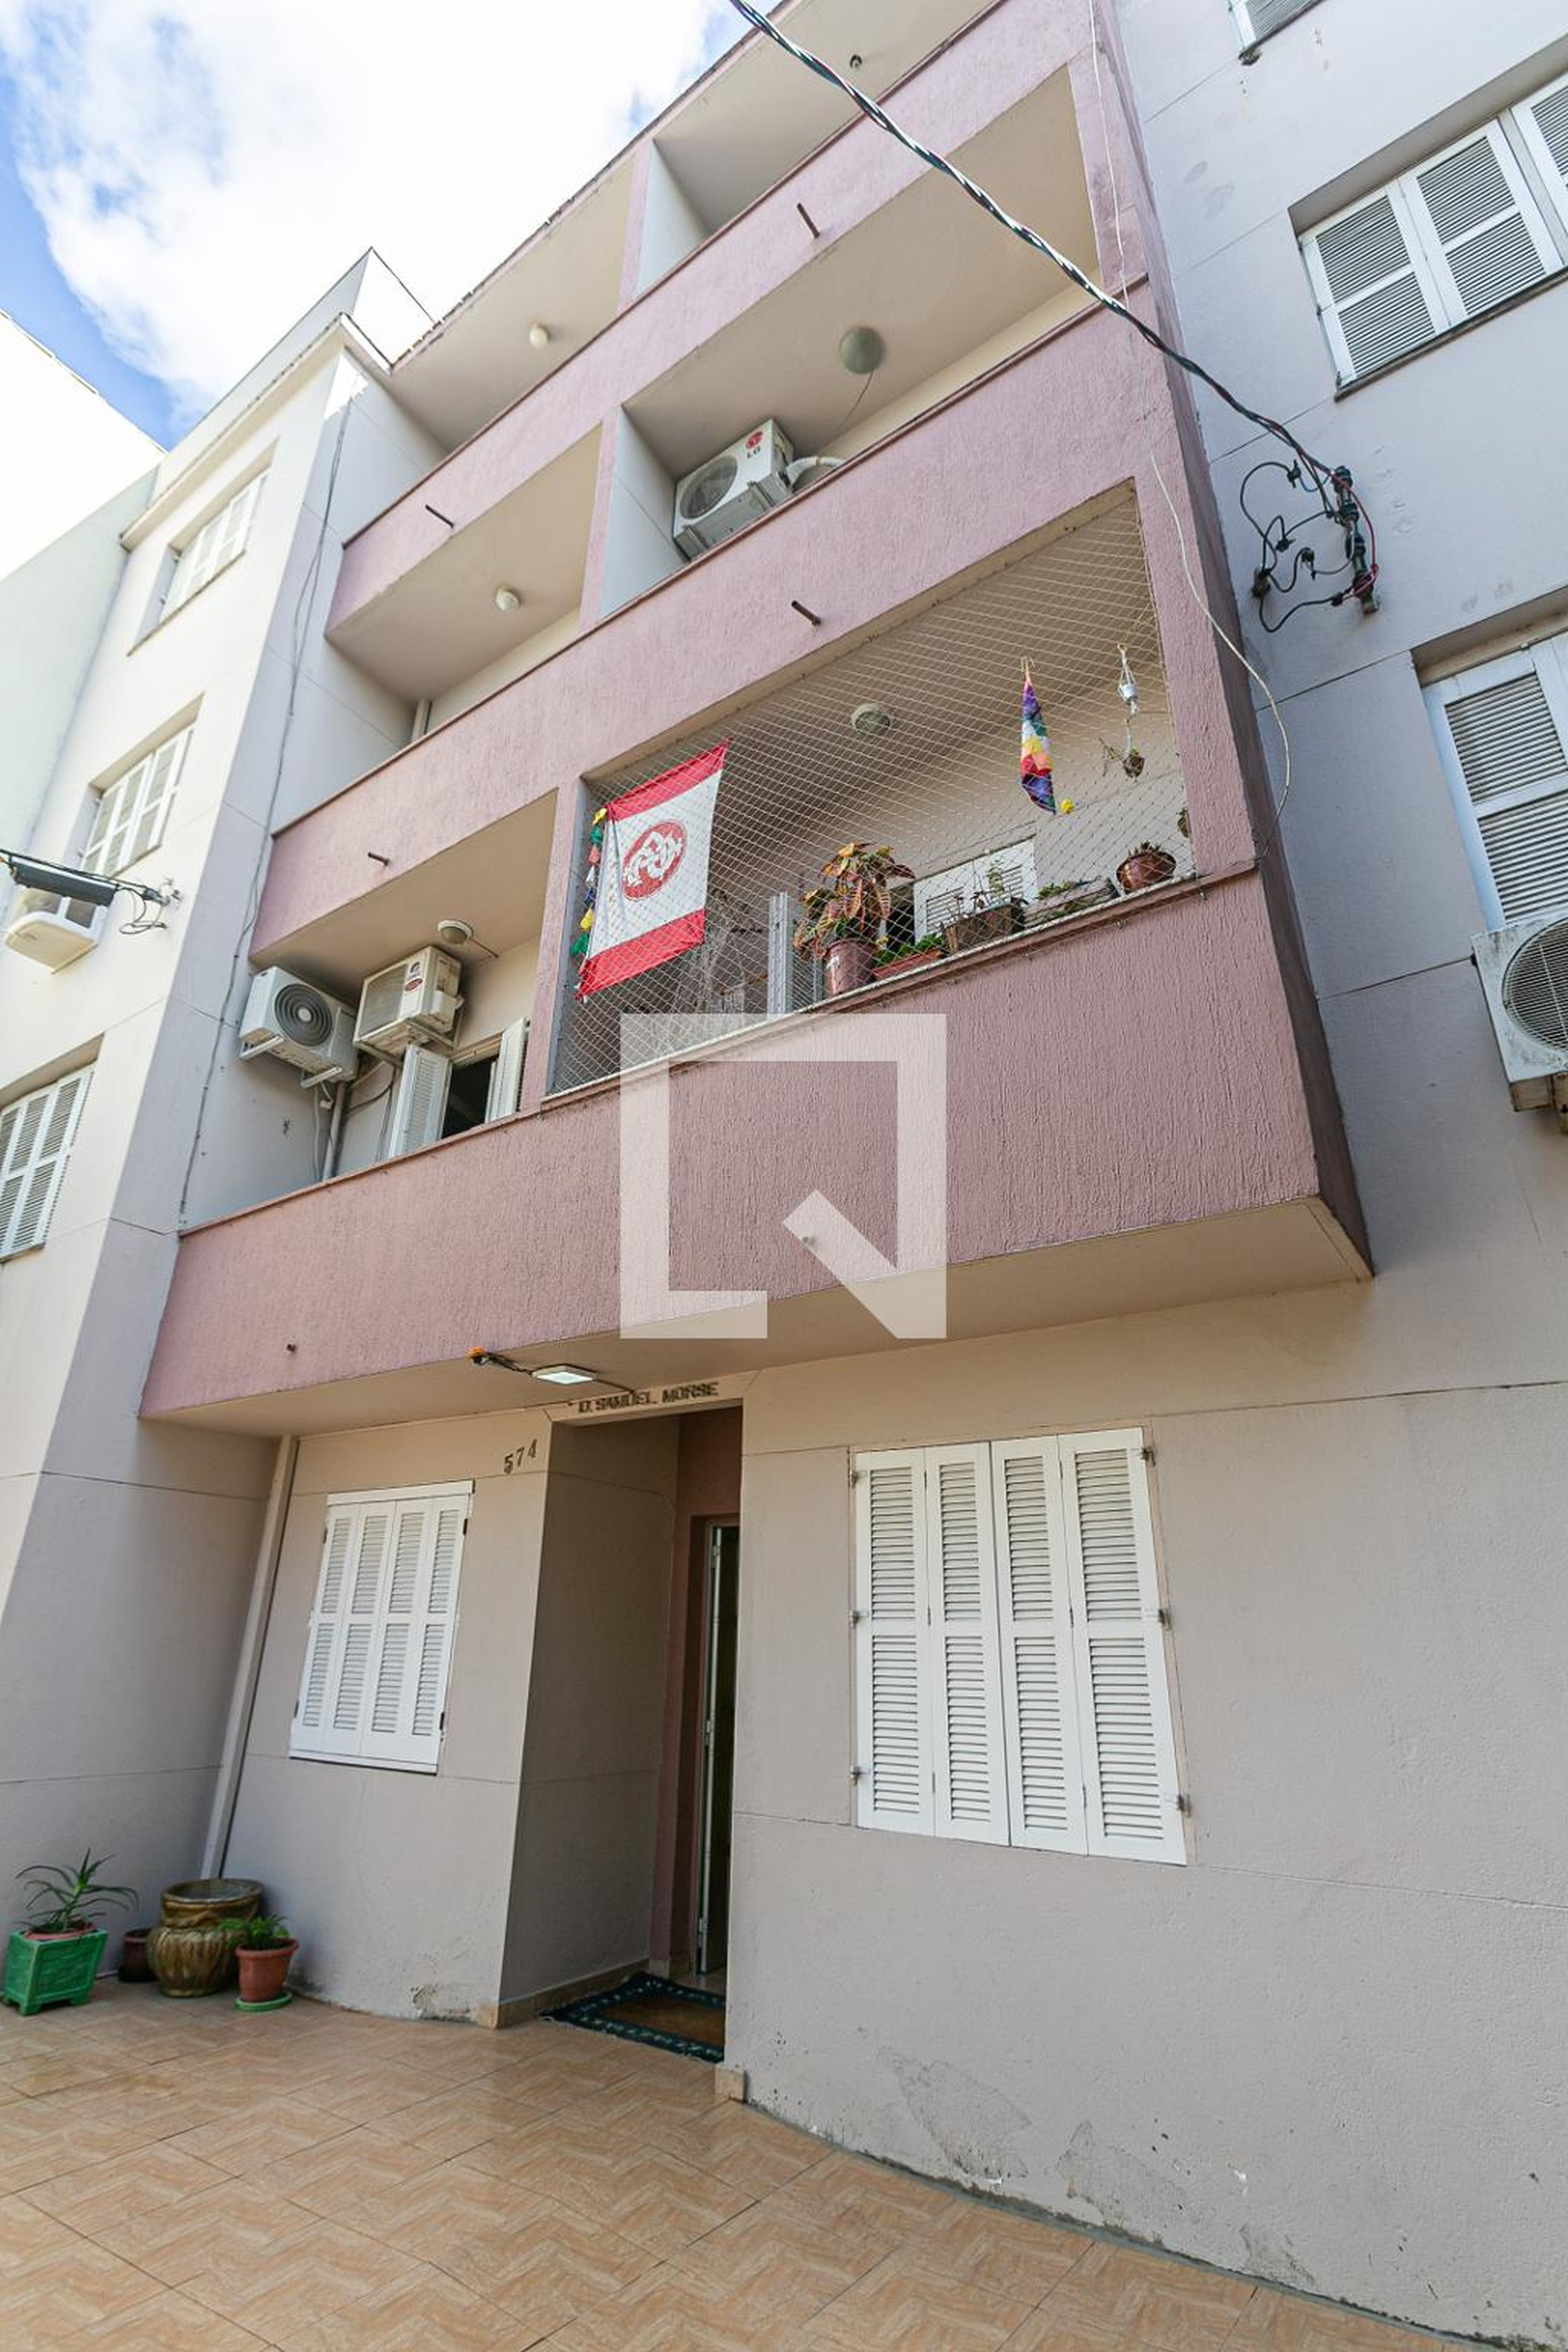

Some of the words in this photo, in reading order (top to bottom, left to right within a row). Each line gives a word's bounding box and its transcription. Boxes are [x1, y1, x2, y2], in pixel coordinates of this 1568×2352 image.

[595, 1391, 657, 1410] SAMUEL
[661, 1382, 719, 1403] MORSE
[503, 1438, 538, 1474] 574
